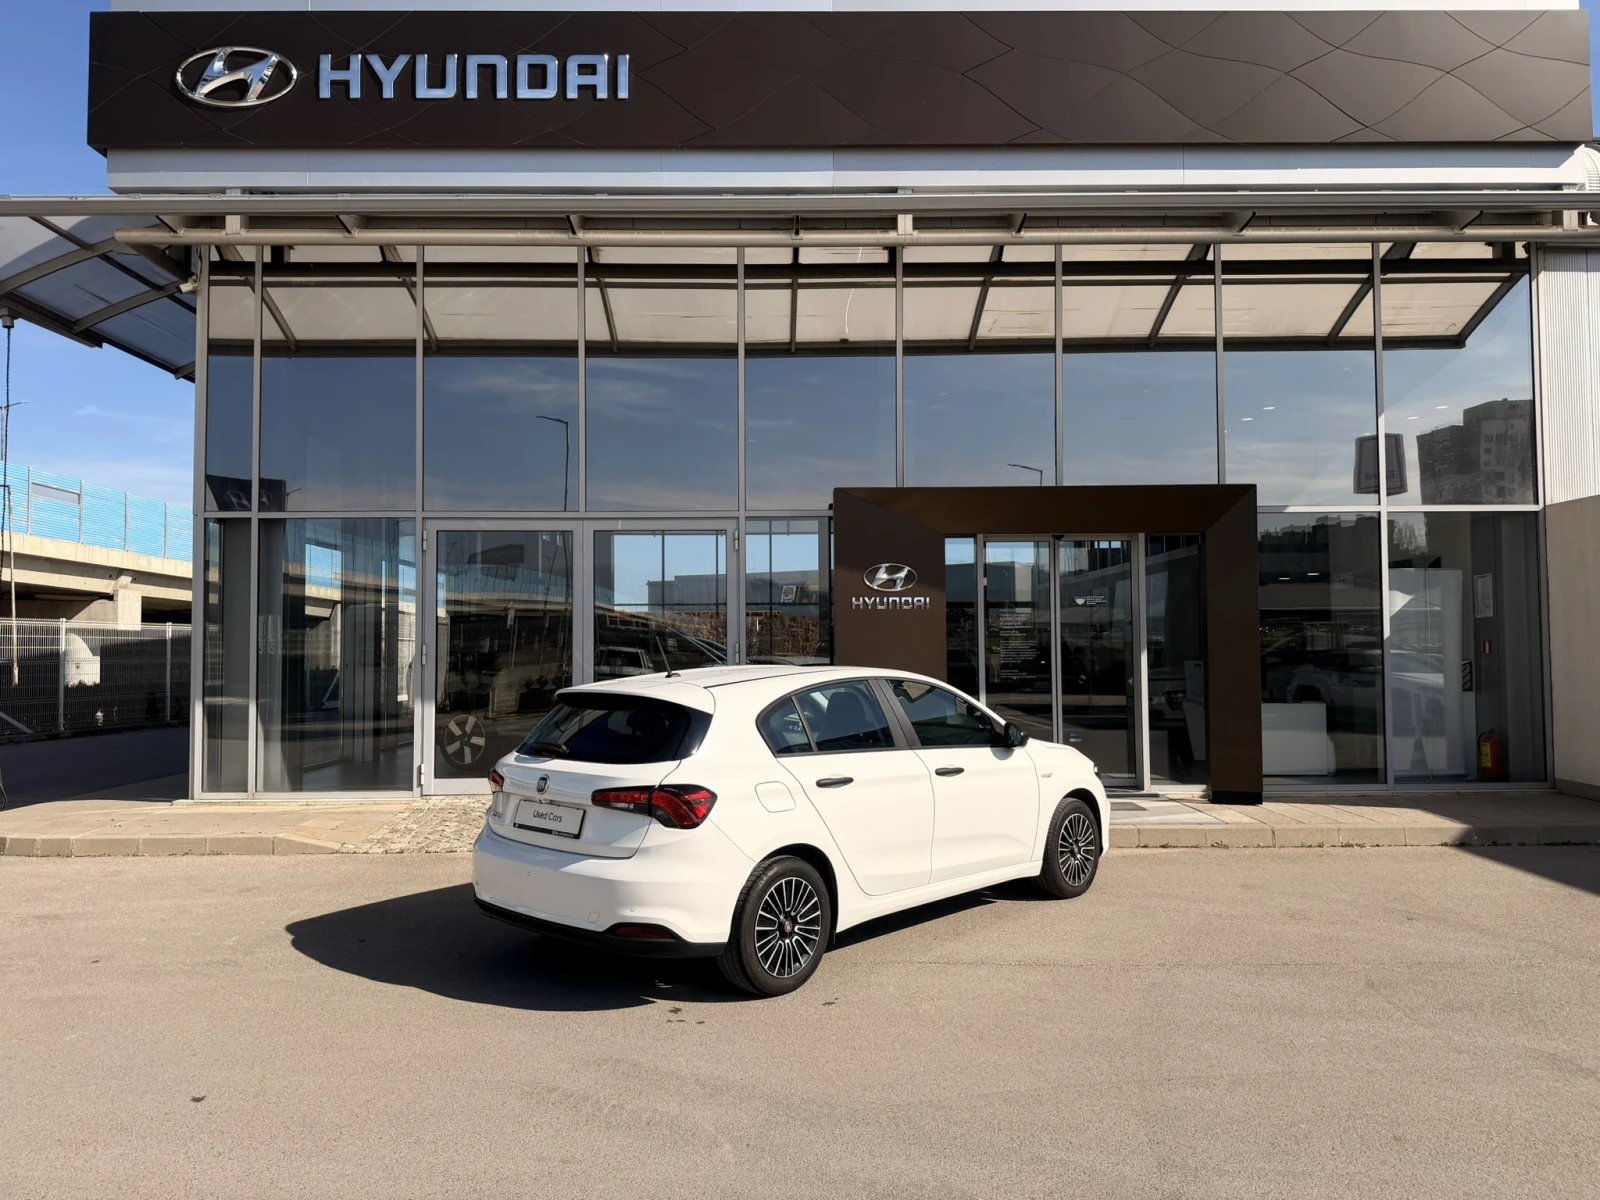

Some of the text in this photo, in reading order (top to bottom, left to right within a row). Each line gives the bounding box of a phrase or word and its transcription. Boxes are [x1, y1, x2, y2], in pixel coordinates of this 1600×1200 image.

[318, 53, 630, 99] HYUNDAI
[851, 596, 930, 610] HYUNDAI
[533, 809, 563, 823] Used Cars
